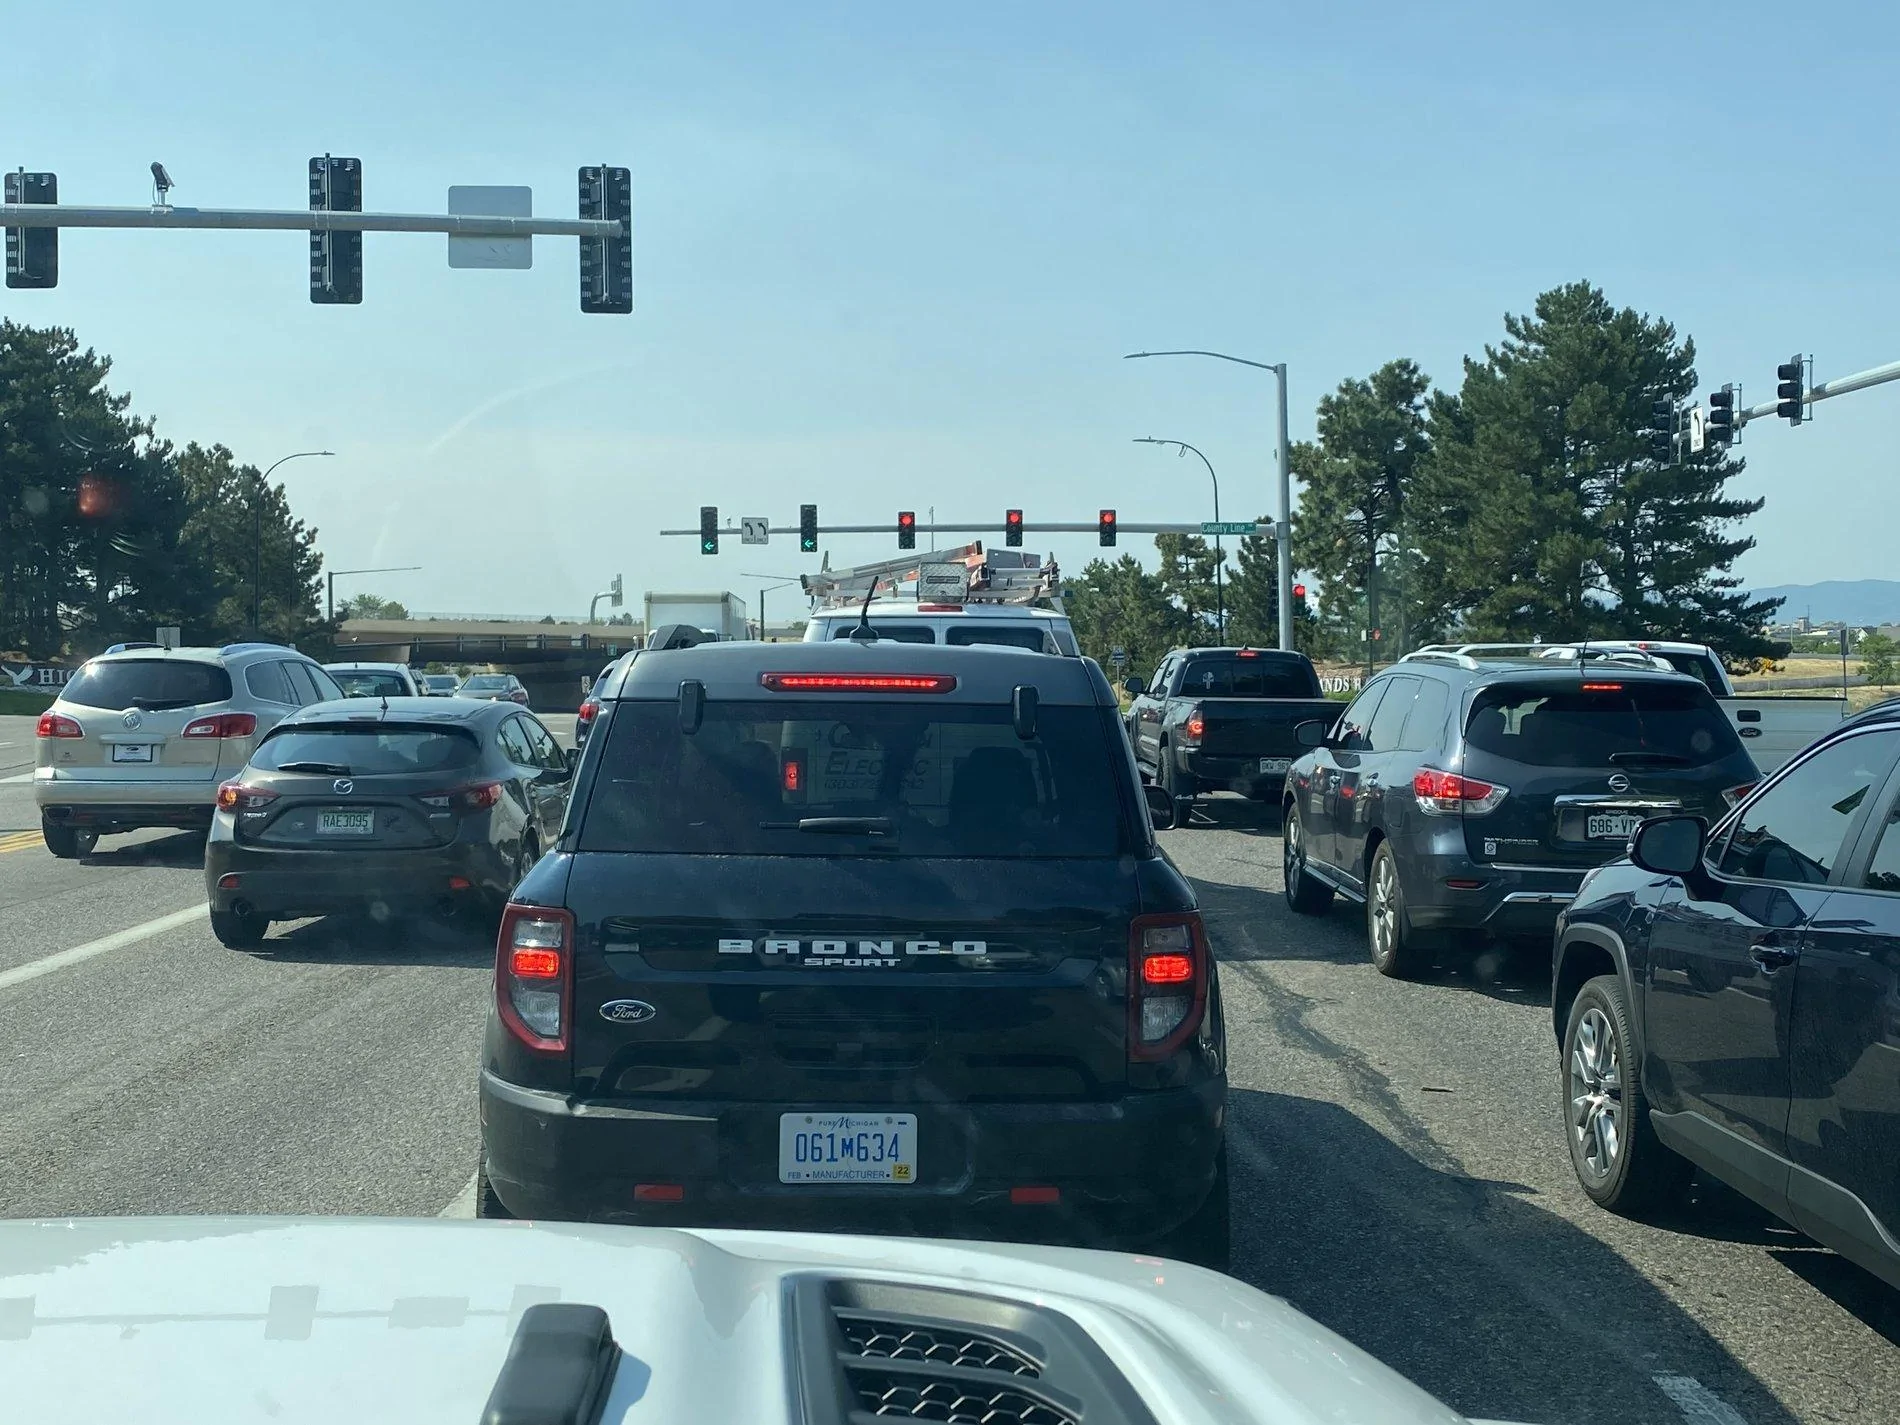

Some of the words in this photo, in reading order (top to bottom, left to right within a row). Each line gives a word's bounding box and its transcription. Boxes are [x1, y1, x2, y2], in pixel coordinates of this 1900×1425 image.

[1230, 523, 1246, 533] Line
[718, 939, 987, 955] BRONCO
[804, 957, 901, 967] SPORT
[612, 1004, 643, 1018] Ford
[795, 1132, 900, 1163] 061M634
[787, 1171, 801, 1179] FEB
[812, 1170, 885, 1180] MANUFACTURER
[897, 1166, 909, 1175] 22
